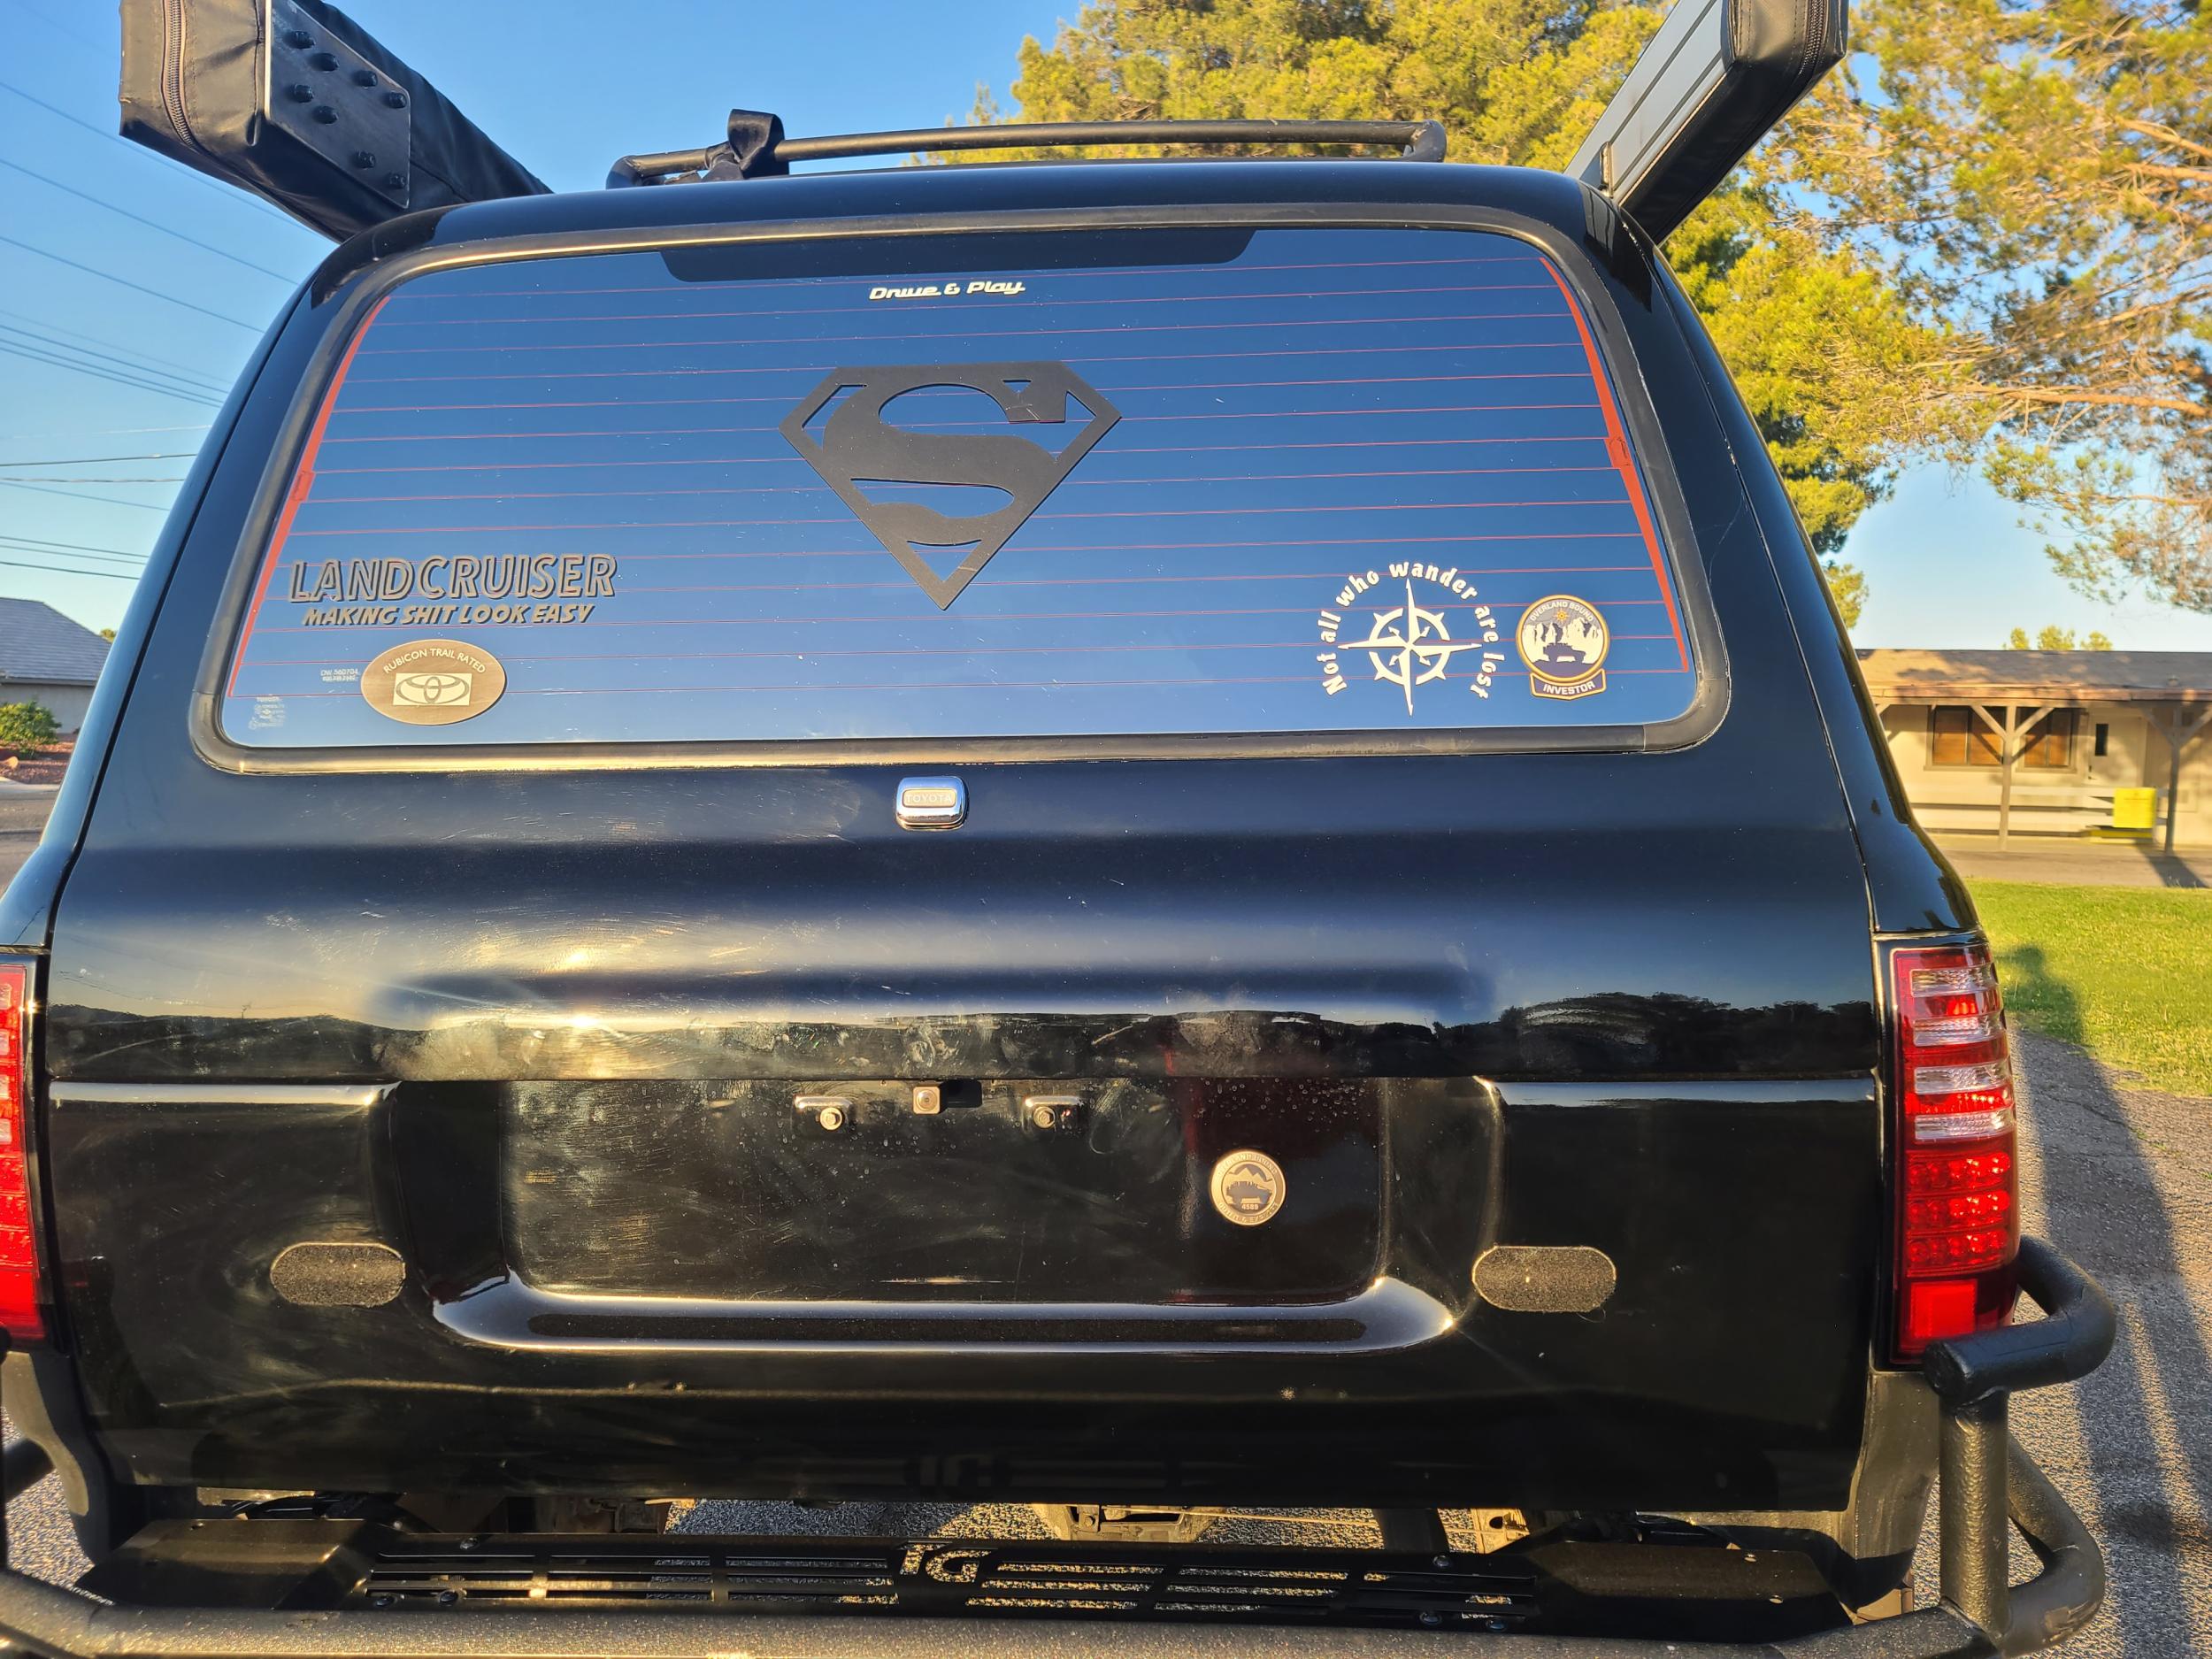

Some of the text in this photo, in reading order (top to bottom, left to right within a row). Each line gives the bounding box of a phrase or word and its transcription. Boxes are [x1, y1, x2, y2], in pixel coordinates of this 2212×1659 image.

[943, 282, 961, 295] &
[966, 280, 1026, 295] Play
[303, 603, 595, 626] MAKING SHIT LOOK EASY
[1530, 601, 1594, 622] OVERLAND BOUND
[1316, 561, 1505, 699] Not all who wander are lost
[382, 648, 487, 674] RUBICON TRAIL RATED
[1543, 680, 1596, 695] INVESTOR
[905, 793, 953, 804] TOYOTA
